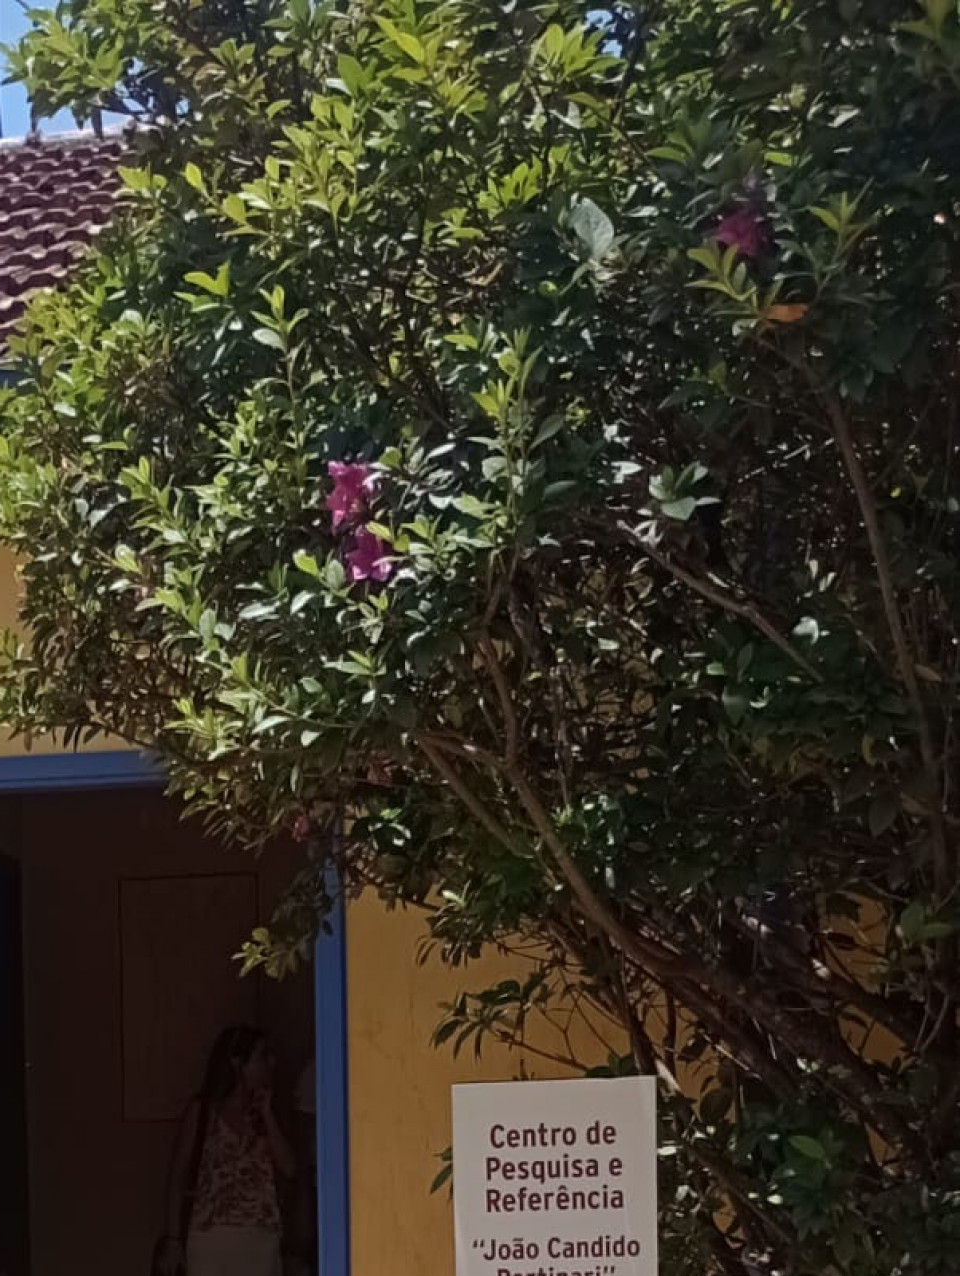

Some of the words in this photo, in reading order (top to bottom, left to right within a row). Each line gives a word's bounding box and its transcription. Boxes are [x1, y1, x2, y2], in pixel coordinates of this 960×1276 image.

[490, 1123, 576, 1148] Centro
[586, 1121, 617, 1145] de
[485, 1153, 599, 1183] Pesquisa
[609, 1157, 623, 1176] e
[486, 1184, 623, 1212] Referência
[548, 1235, 640, 1258] Candido
